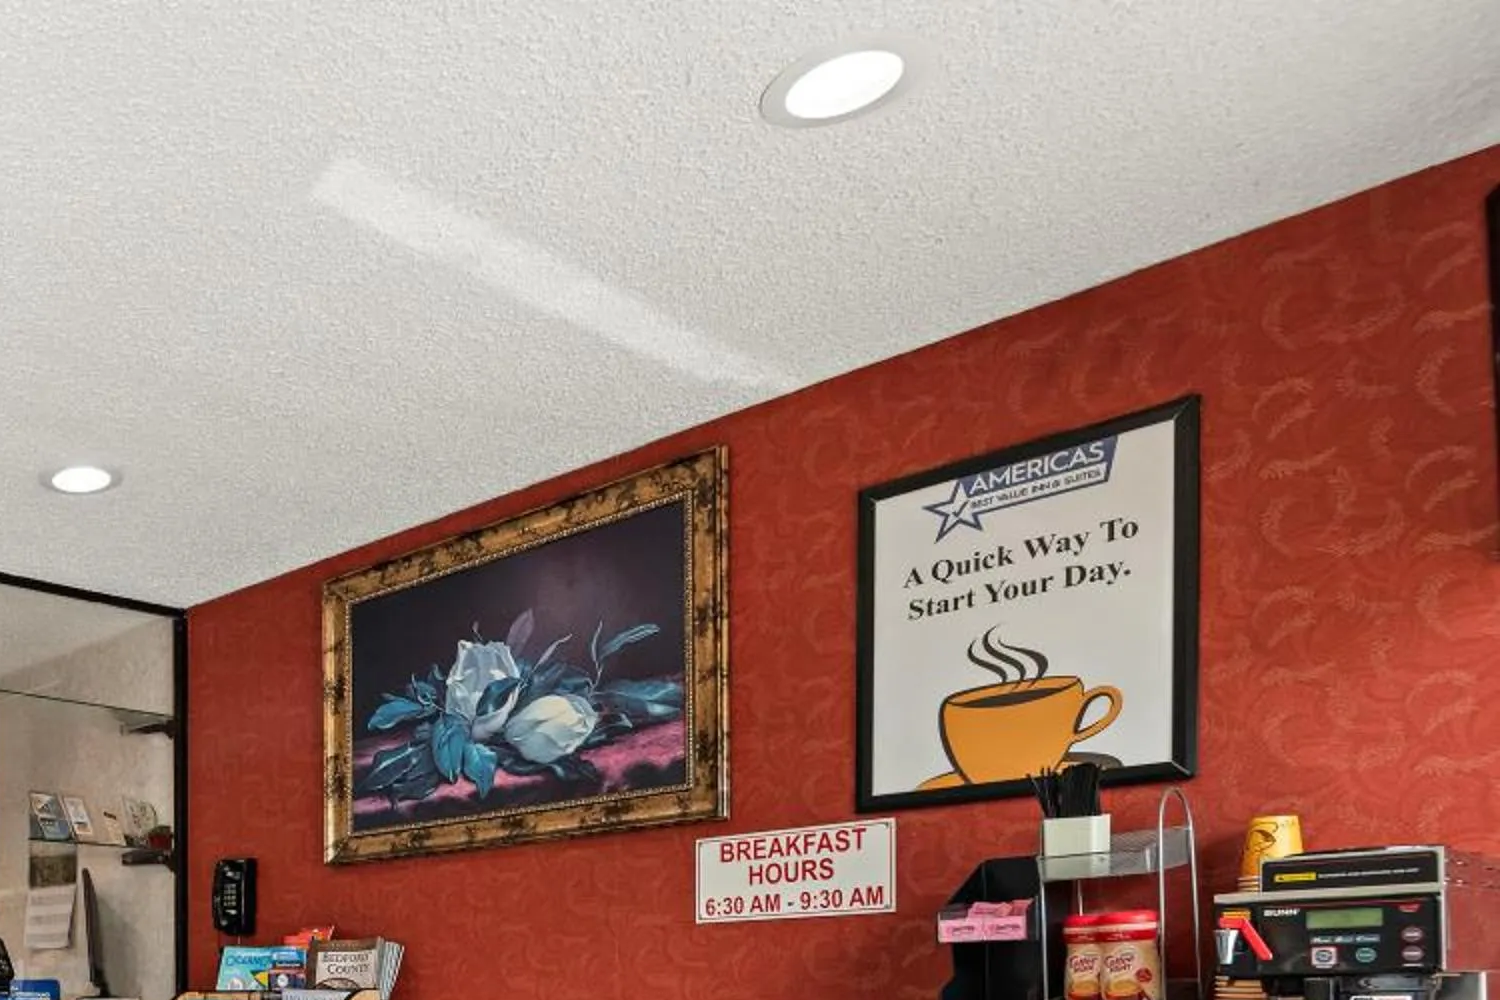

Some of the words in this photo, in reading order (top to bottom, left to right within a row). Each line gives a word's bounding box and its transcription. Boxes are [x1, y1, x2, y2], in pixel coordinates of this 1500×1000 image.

[969, 441, 1105, 494] AMERICAS
[1031, 483, 1051, 495] INN
[903, 567, 924, 589] A
[931, 544, 1013, 583] Quick
[1023, 529, 1090, 560] Way
[1099, 516, 1139, 543] To
[908, 593, 975, 621] Start
[984, 573, 1055, 605] Your
[1064, 560, 1132, 591] Day.
[719, 828, 867, 863] BREAKFAST
[749, 858, 835, 886] HOURS
[705, 897, 745, 917] 6:30
[750, 894, 781, 913] AM
[800, 889, 843, 911] 9:30
[849, 886, 884, 907] AM
